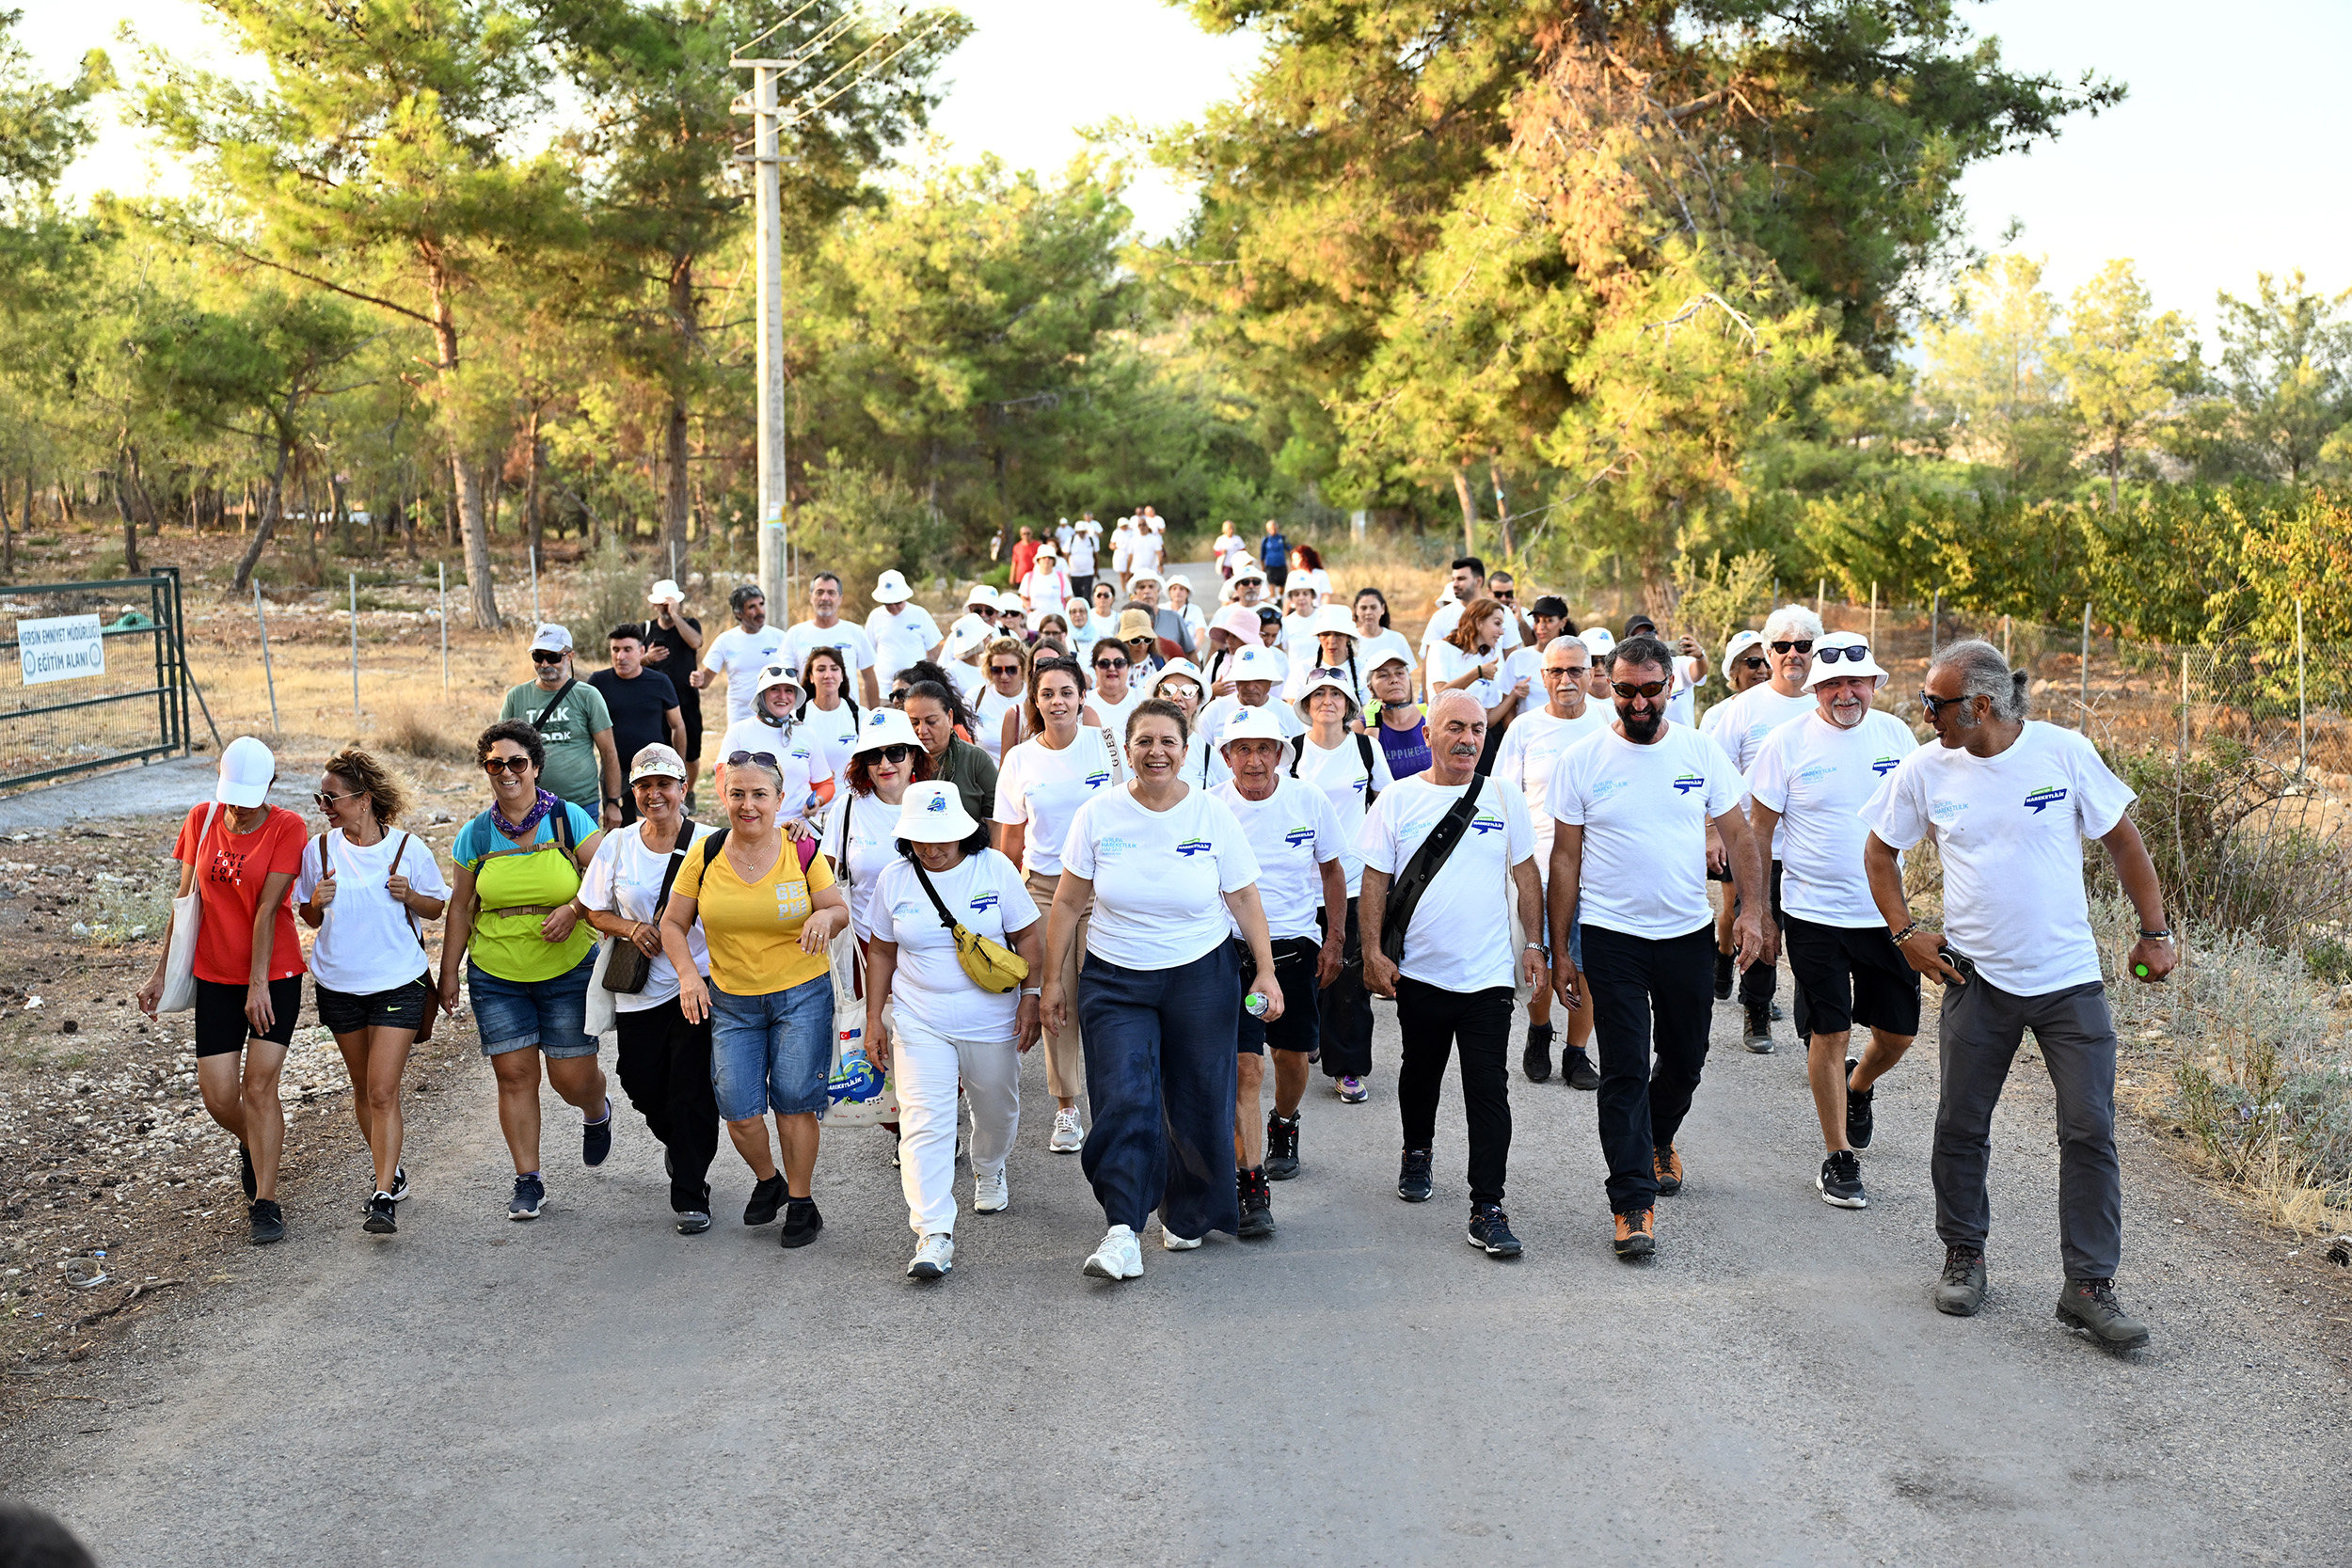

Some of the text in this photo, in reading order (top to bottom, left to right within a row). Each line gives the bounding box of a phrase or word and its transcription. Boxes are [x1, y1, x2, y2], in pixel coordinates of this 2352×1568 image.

[20, 621, 100, 646] MERSİN EMNİYET MÜDÜRLÜĞÜ
[38, 652, 88, 673] EĞİTİM ALANI
[1103, 728, 1120, 768] GUESS
[217, 850, 246, 861] LOVE
[215, 858, 244, 868] LOVE
[212, 866, 243, 877] LOFT
[212, 875, 242, 886] LOFT
